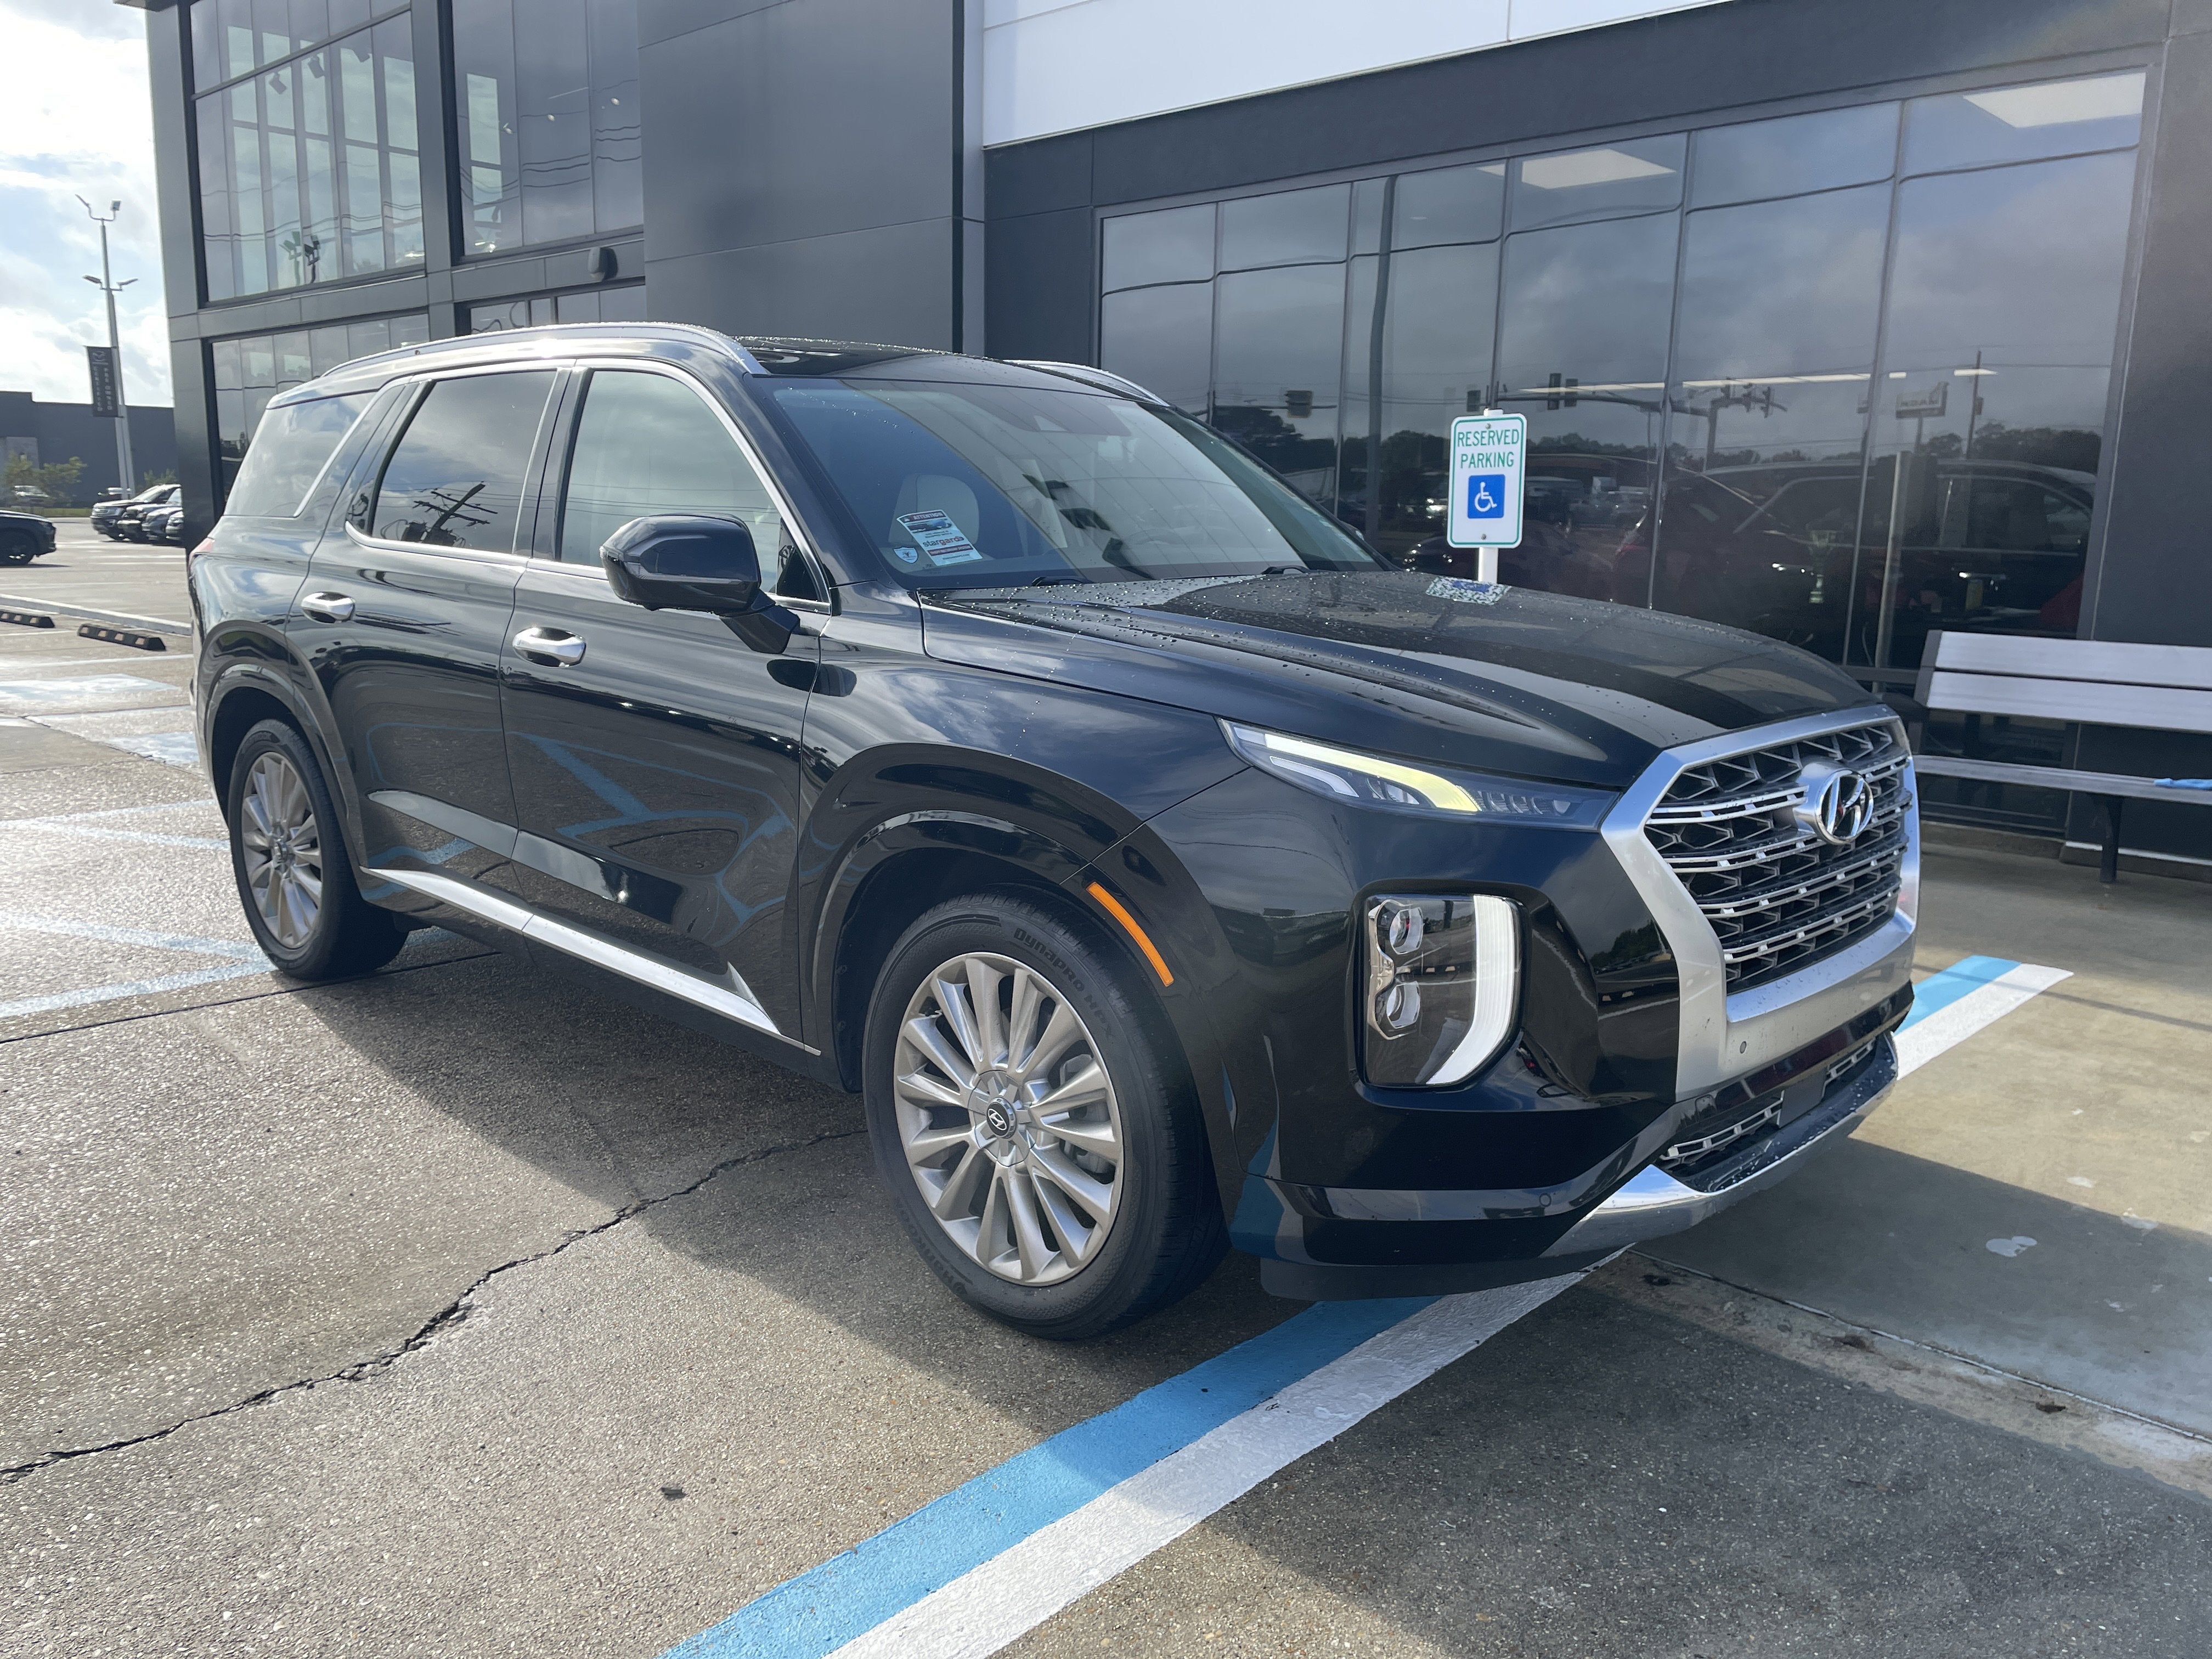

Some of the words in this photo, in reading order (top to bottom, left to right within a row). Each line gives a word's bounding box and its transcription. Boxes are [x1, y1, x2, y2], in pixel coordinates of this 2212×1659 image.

[1457, 428, 1519, 447] RESERVED
[1460, 452, 1514, 469] PARKING
[913, 512, 944, 520] ATTENTION
